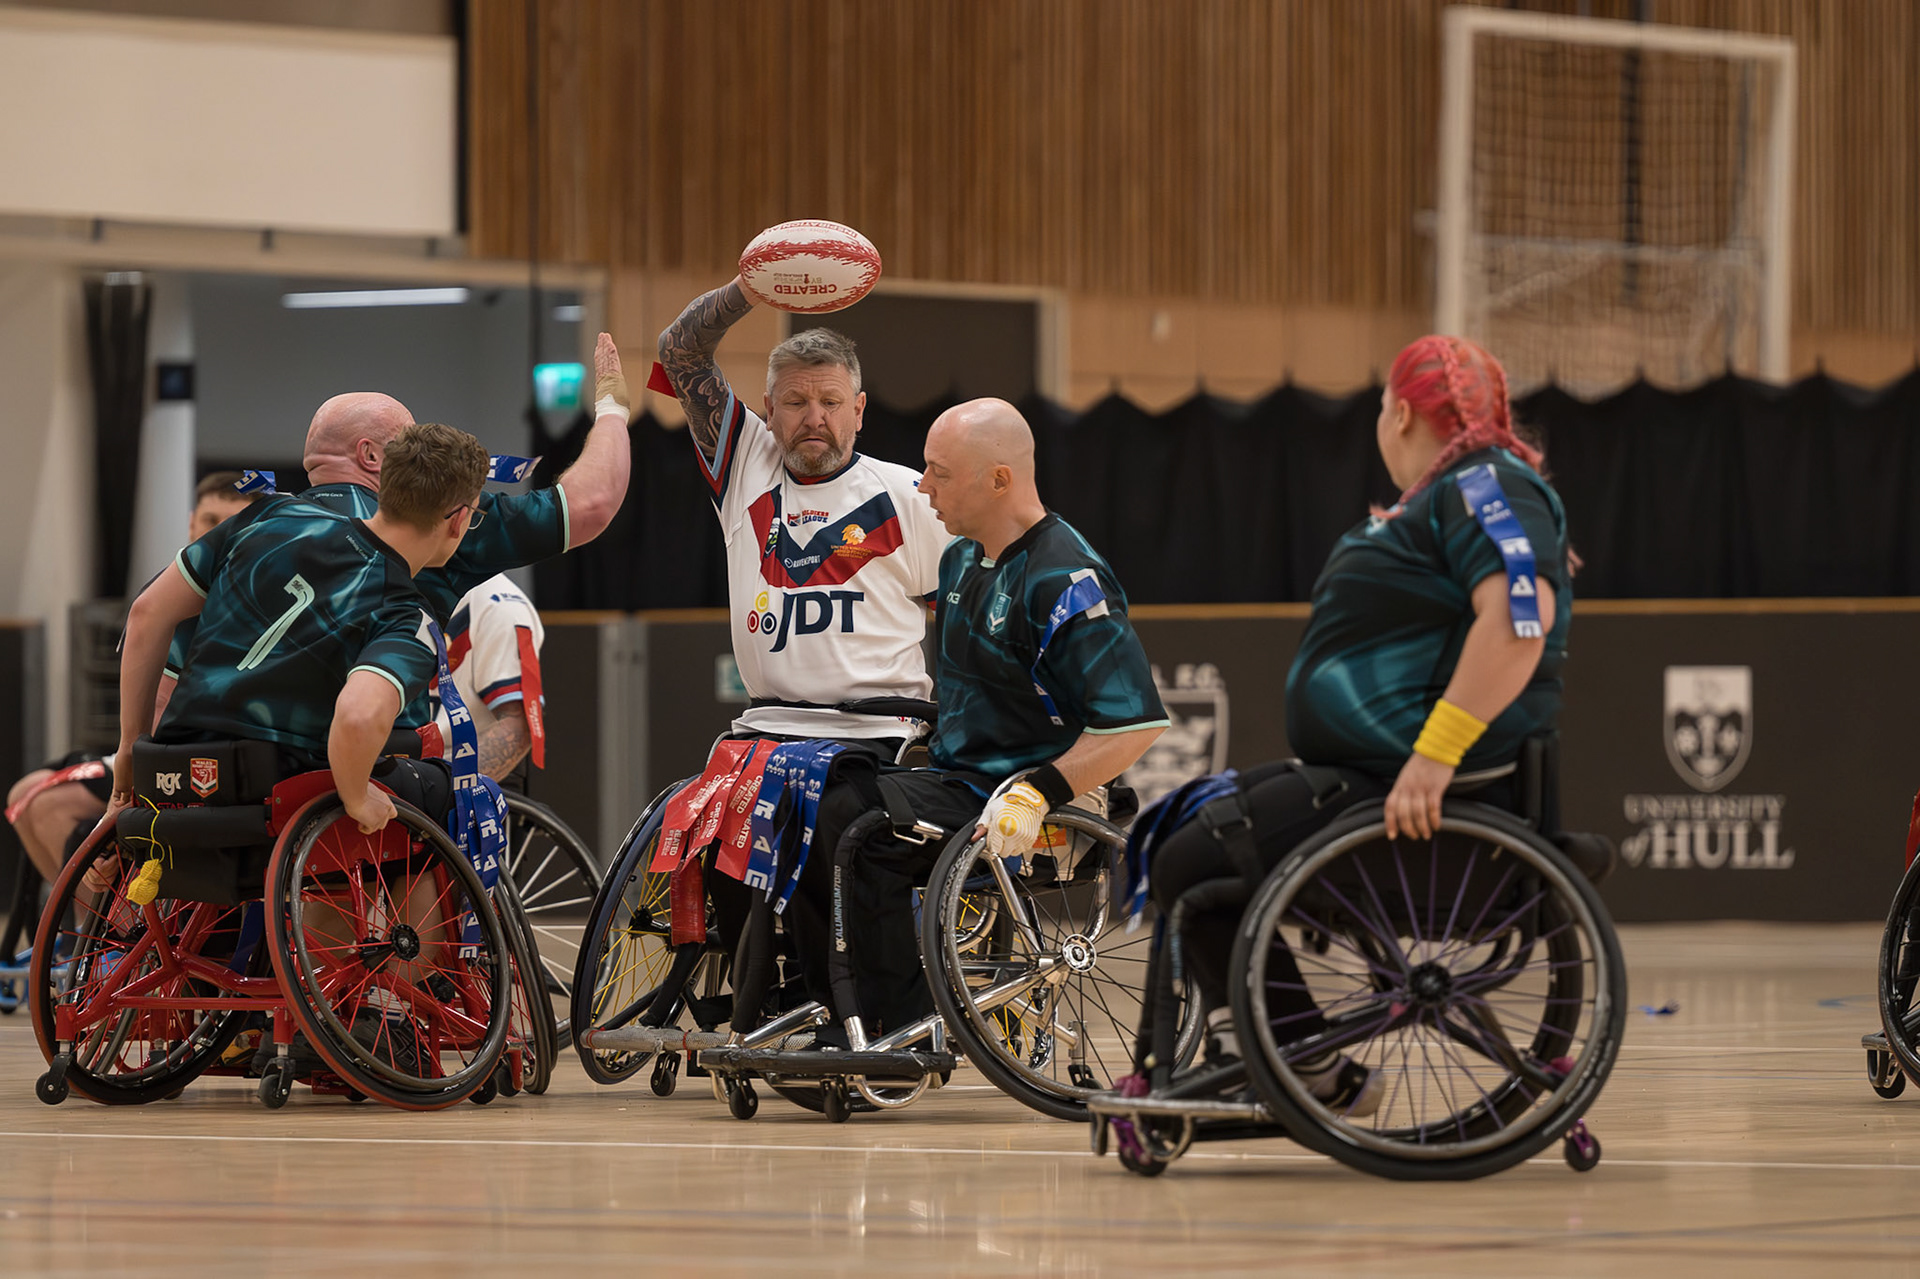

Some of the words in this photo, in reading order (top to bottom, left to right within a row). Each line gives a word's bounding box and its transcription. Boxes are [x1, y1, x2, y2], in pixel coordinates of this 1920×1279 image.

[774, 284, 838, 295] CREATED
[769, 591, 865, 653] JDT
[736, 775, 763, 814] CREATED
[1624, 794, 1786, 822] UNIVERSITY
[705, 802, 722, 838] CREATED
[669, 829, 682, 856] REATED
[1650, 819, 1796, 869] HULL
